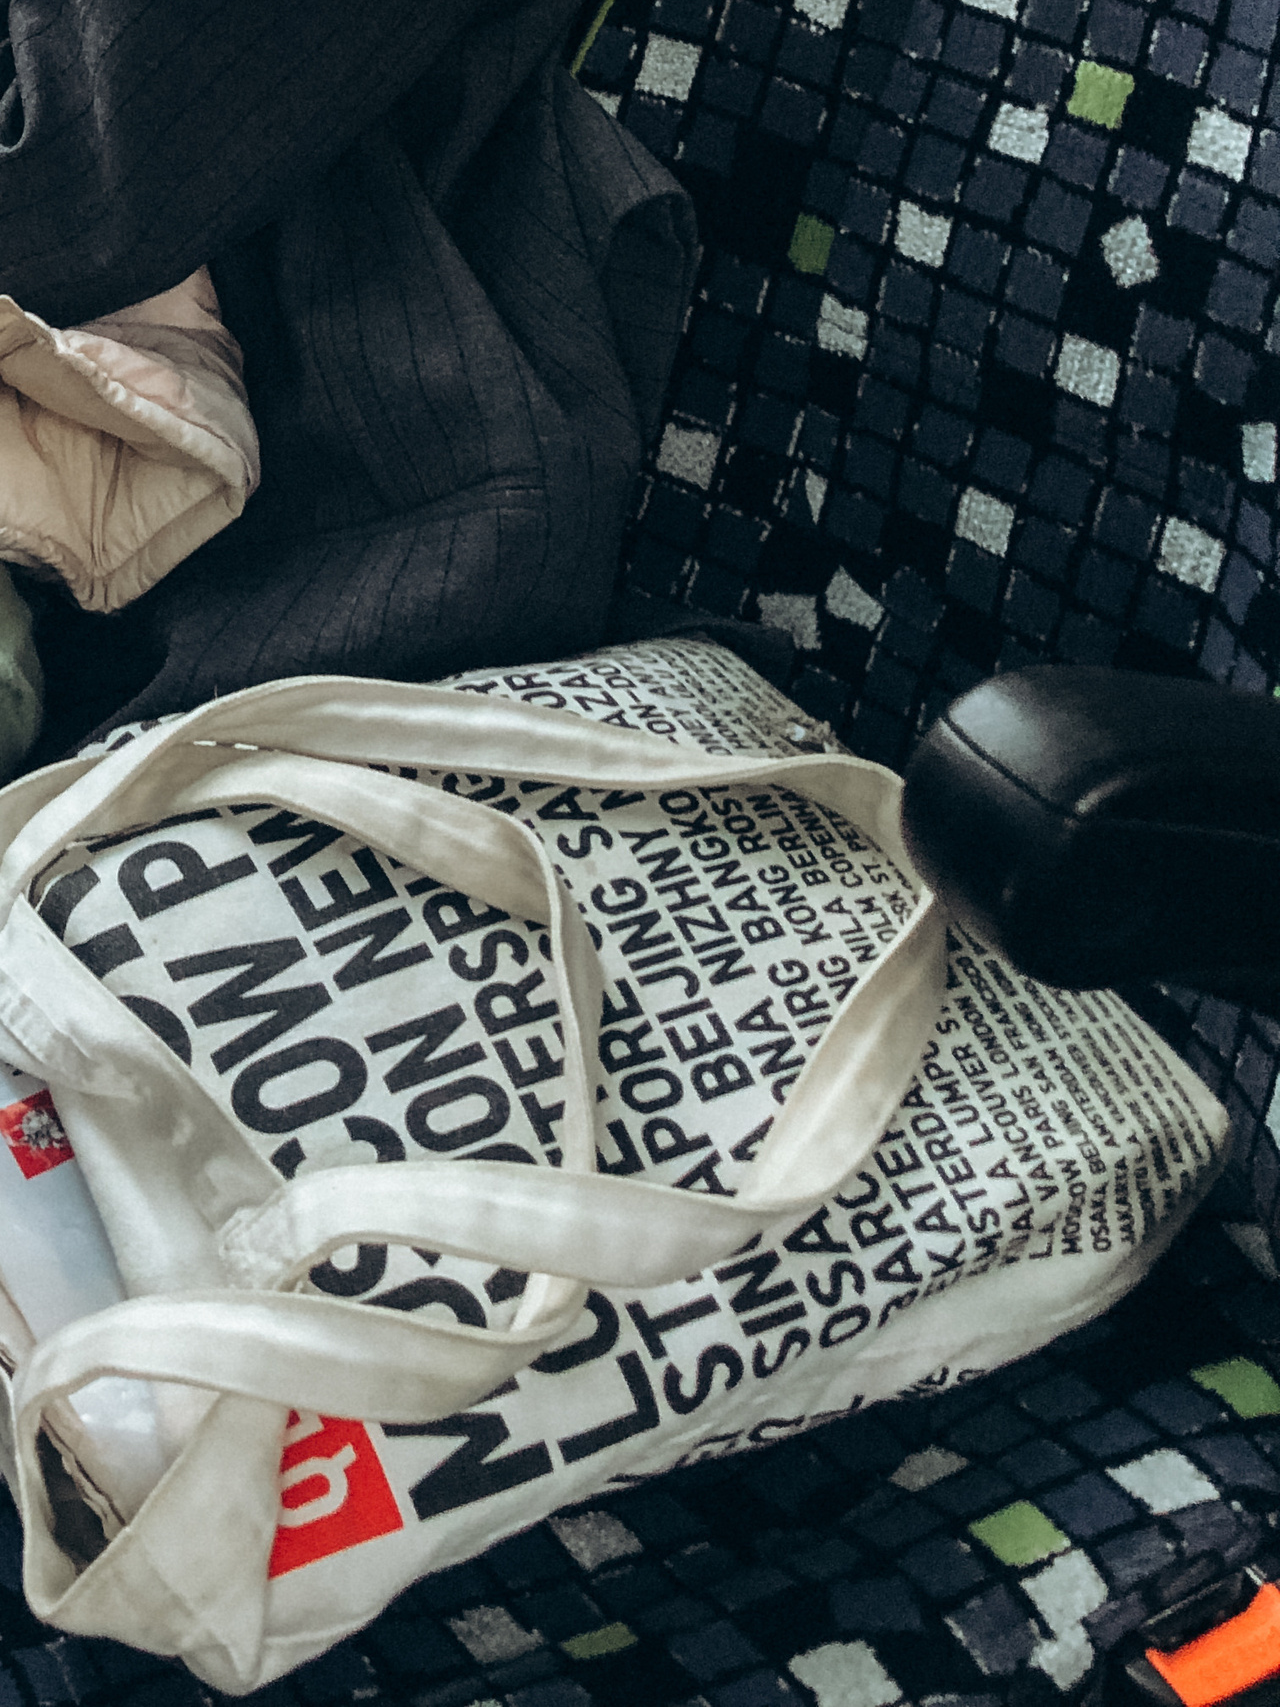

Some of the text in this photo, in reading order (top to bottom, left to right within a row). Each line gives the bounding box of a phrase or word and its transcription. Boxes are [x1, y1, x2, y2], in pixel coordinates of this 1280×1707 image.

[657, 786, 785, 945] BANGKO
[742, 789, 831, 887] BERLIN
[766, 782, 863, 888] COPENHA
[618, 827, 756, 986] NIZHNY
[757, 864, 832, 946] KONG
[822, 896, 877, 963] NILA
[590, 877, 755, 1103] BEIJING
[951, 994, 1020, 1079] LONDON
[1012, 1001, 1051, 1043] HONG
[920, 1039, 995, 1147] LUMPU
[951, 952, 1113, 1253] OSAKA BEIJING SAN FRANCISCO
[951, 1042, 1060, 1202] VANCOUVER
[1011, 1085, 1064, 1150] PARIS
[1043, 1047, 1121, 1148] AMSTERDAM
[597, 978, 812, 1380] SINAPORE
